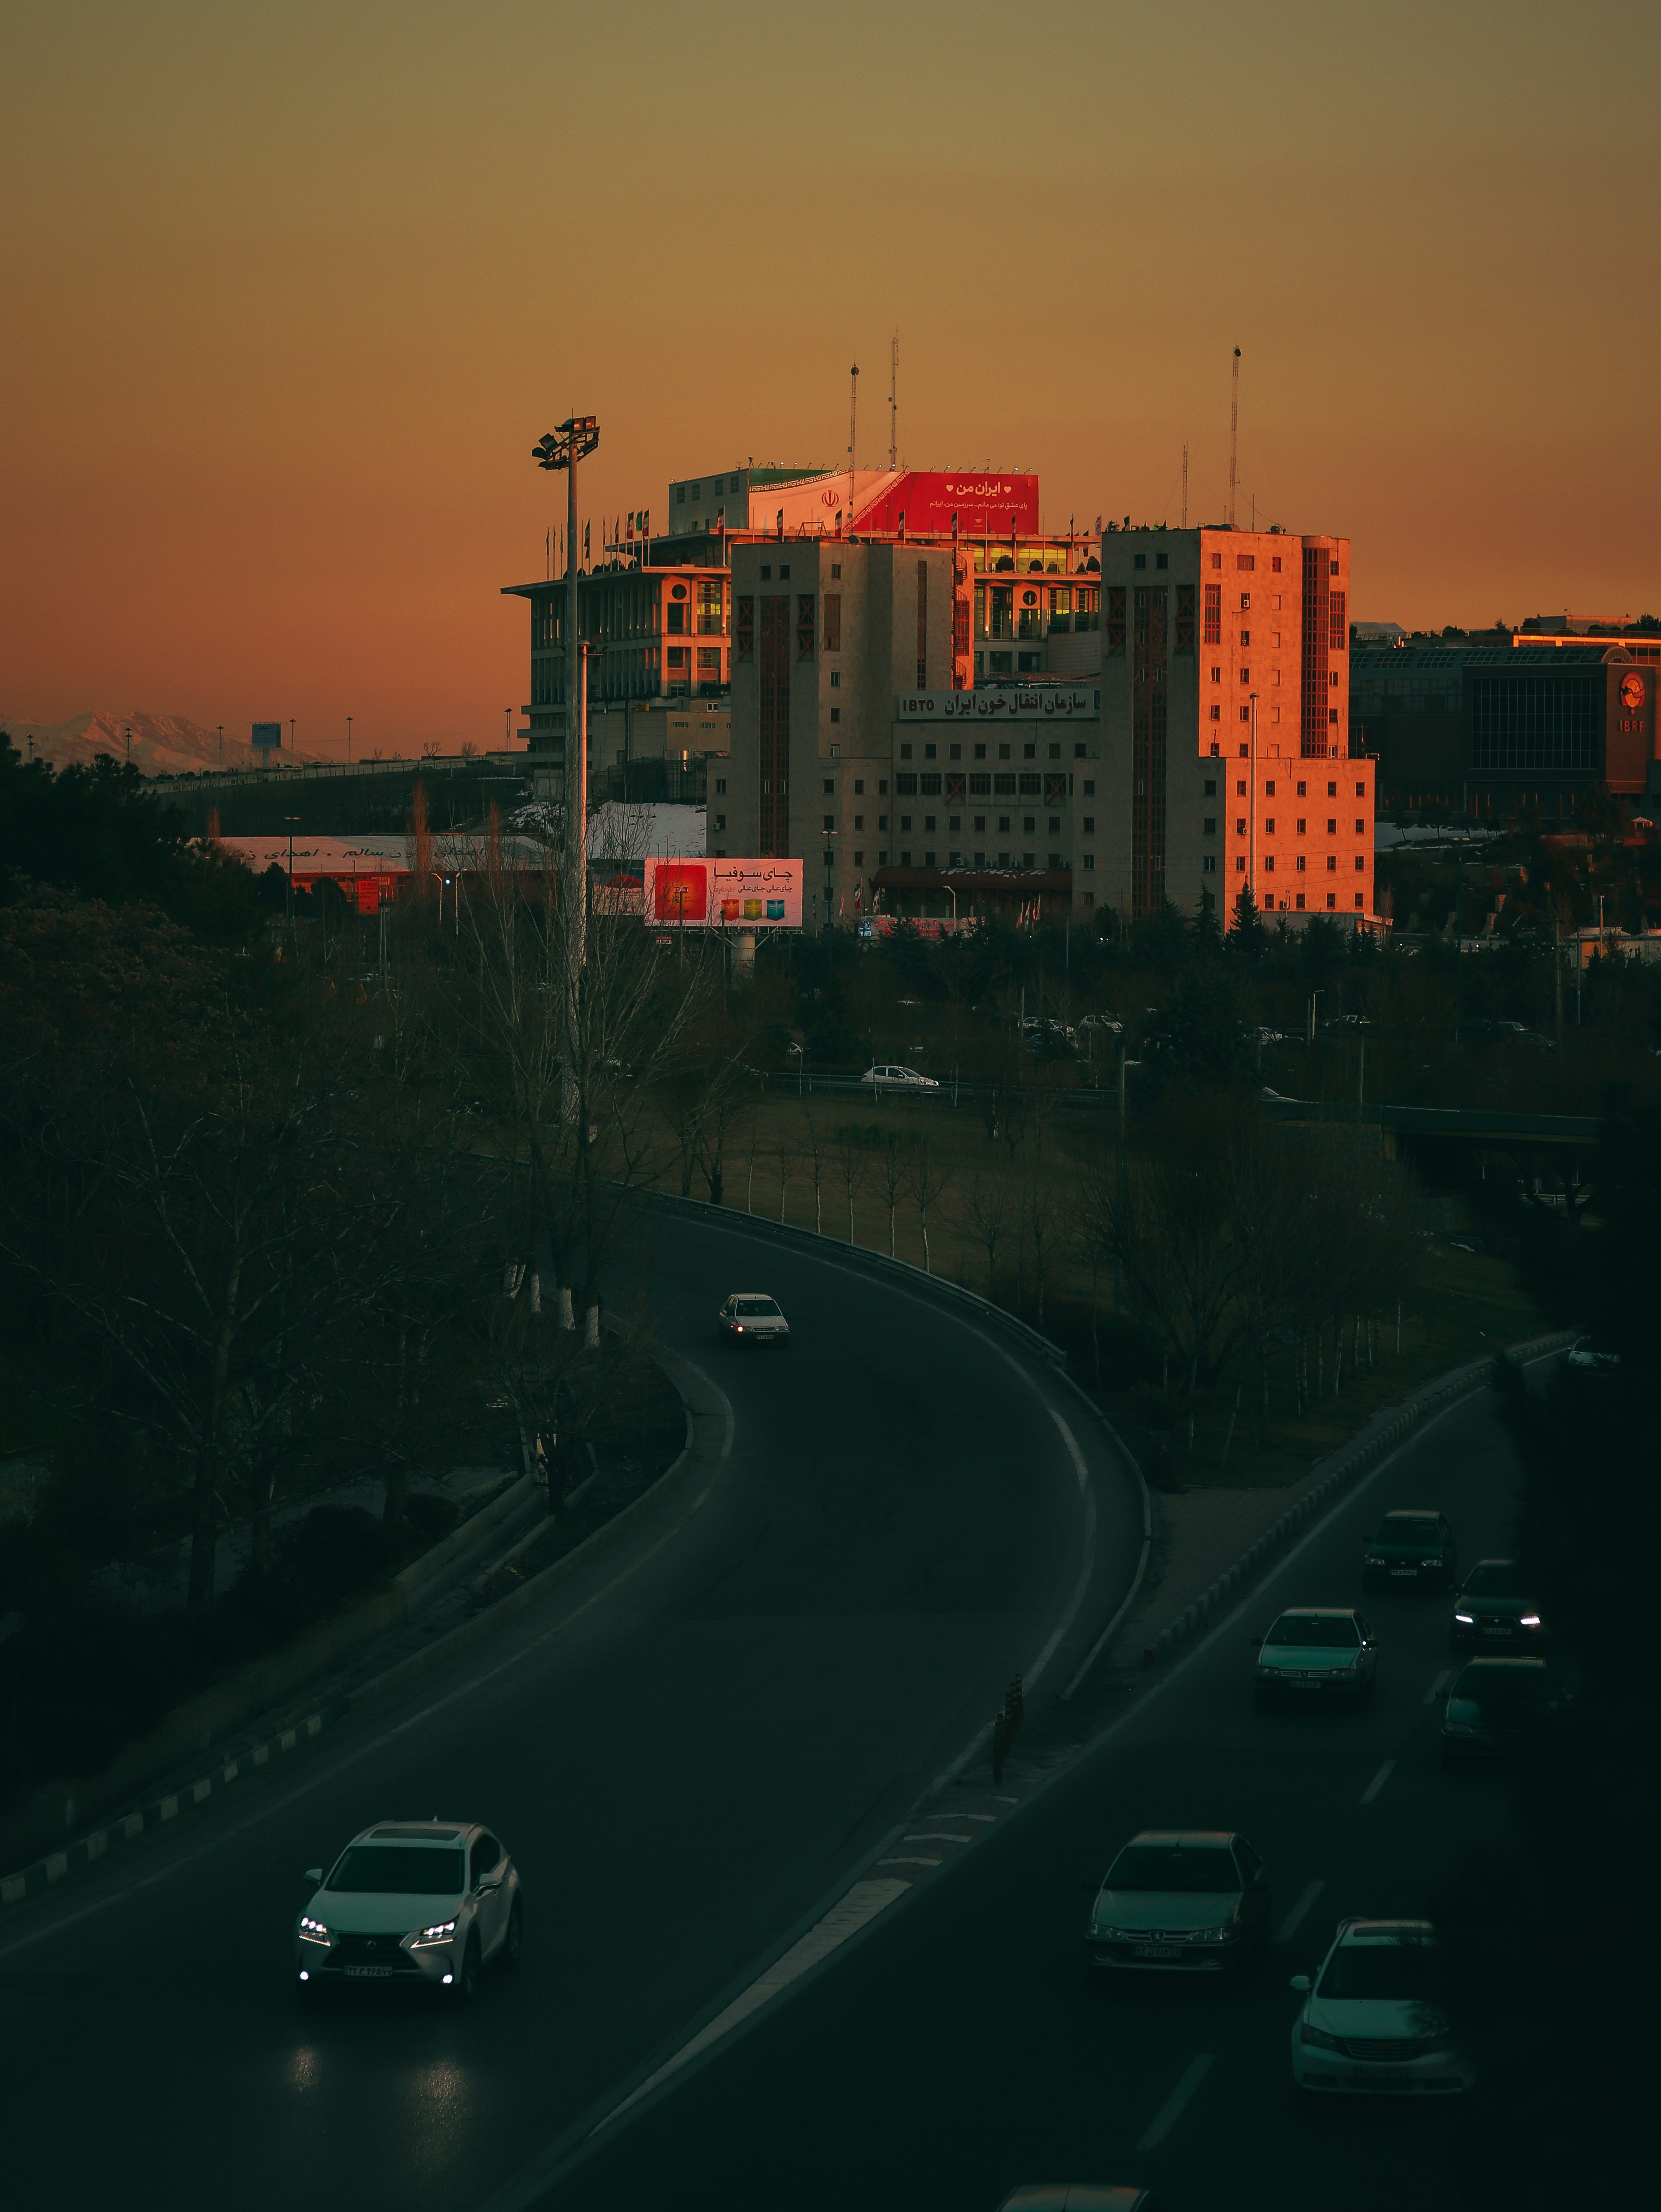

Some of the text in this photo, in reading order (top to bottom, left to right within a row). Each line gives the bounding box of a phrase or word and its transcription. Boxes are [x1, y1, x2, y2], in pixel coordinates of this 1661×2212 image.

[956, 481, 1000, 497] ایران من
[1019, 502, 1027, 510] پای
[903, 699, 935, 711] IBTO
[944, 691, 1086, 715] سازمان انتقال خون ایران
[1620, 720, 1644, 732] IBRF
[264, 848, 319, 859] اهدای
[342, 848, 384, 858] سالم
[390, 849, 419, 858] ون
[714, 866, 793, 883] چای سوفیا
